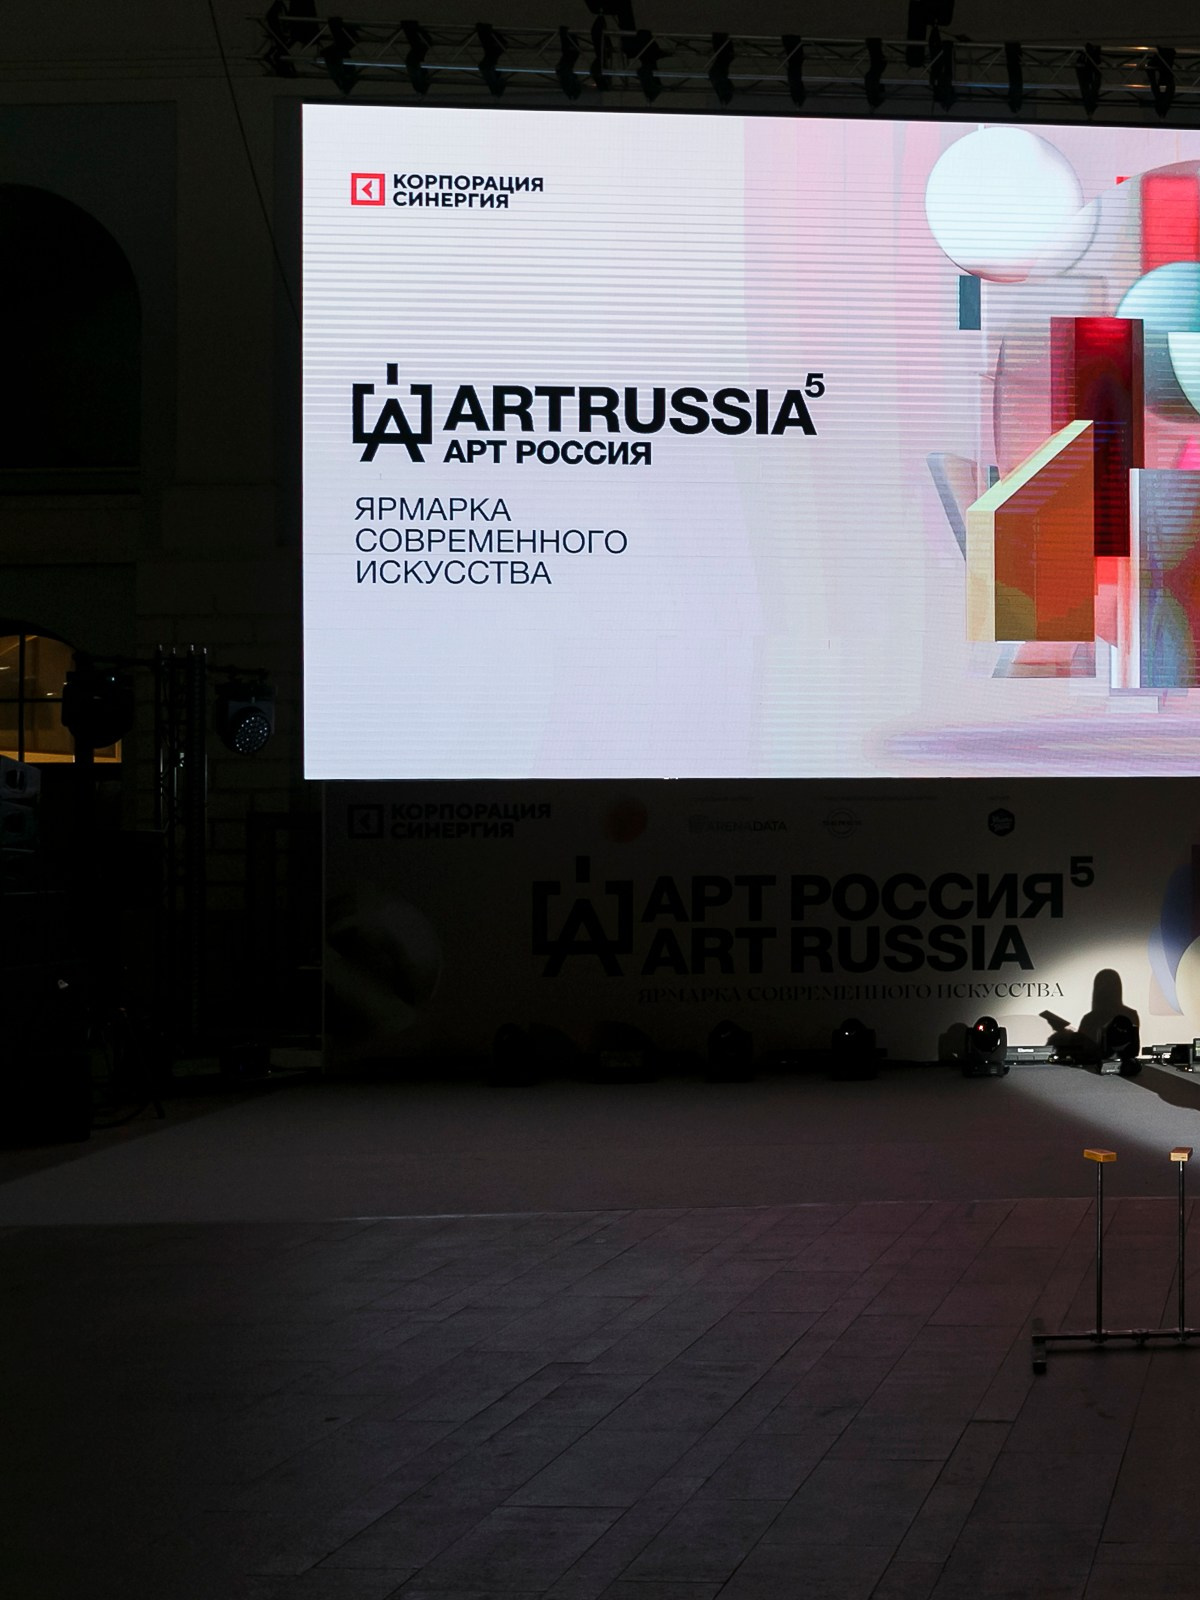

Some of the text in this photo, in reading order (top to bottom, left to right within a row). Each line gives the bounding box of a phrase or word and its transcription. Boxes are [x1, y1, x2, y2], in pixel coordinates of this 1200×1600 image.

[393, 174, 544, 193] КОРПОРАЦИЯ
[393, 191, 509, 208] СИНЕРГИЯ
[443, 439, 652, 465] АРТ РОССИЯ
[354, 496, 511, 522] ЯРМАРКА
[355, 528, 628, 554] СОВРЕМЕННОГО
[356, 559, 552, 585] ИСКУССТВА
[391, 803, 551, 820] КОРПОРАЦИЯ
[391, 822, 514, 838] СИНЕРГИЯ
[641, 875, 776, 922] АРТ
[791, 873, 1063, 920] РОССИЯ
[641, 925, 1035, 976] ART RUSSIA
[638, 982, 1064, 1004] ЯРМАРКА СОВРЕМЕННОГО ИСКУССТВА
